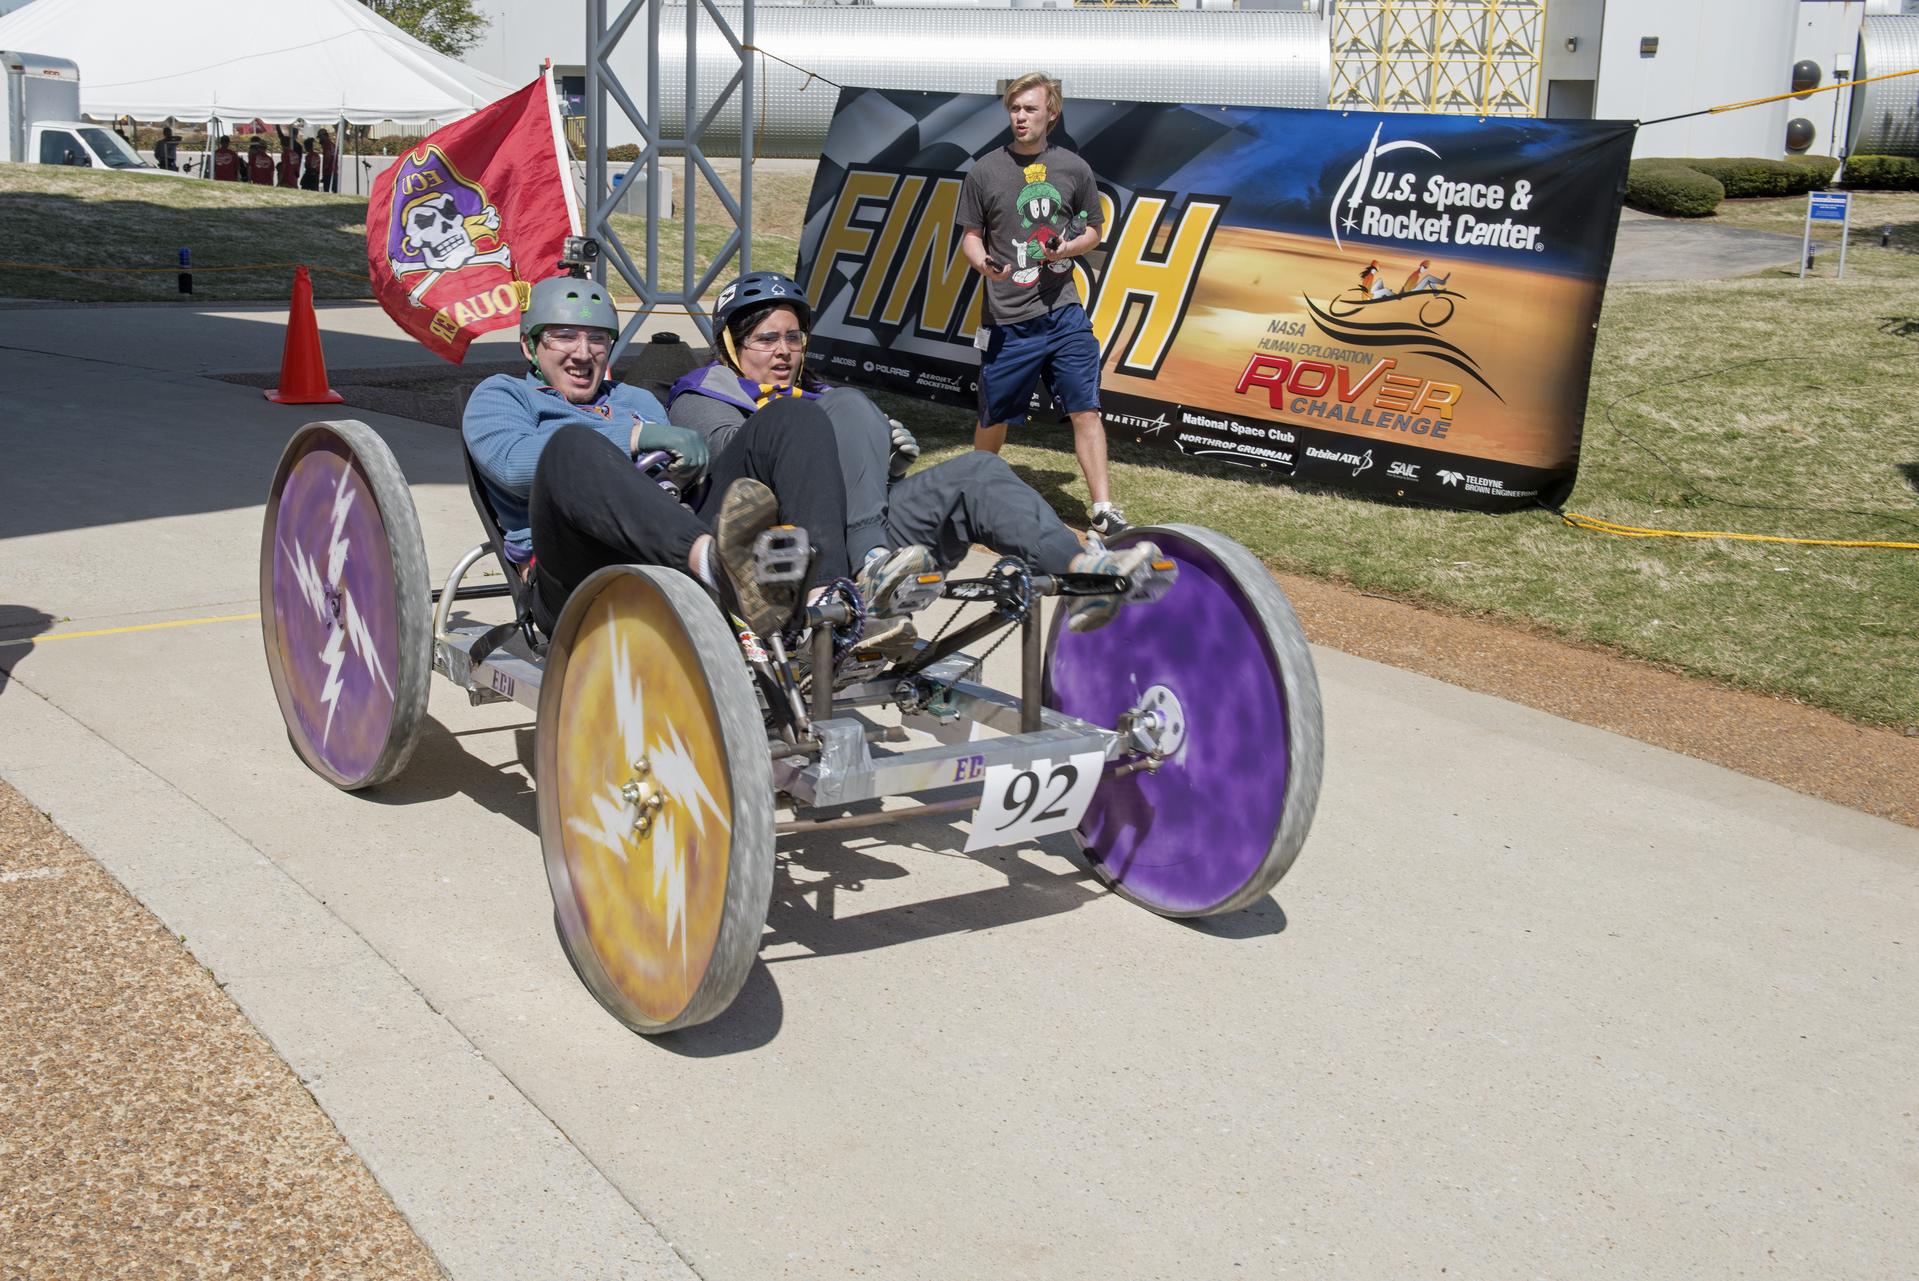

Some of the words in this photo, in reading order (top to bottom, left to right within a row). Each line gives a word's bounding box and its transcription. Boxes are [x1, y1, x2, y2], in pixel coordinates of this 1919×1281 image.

[1371, 171, 1416, 202] U.S.
[1423, 175, 1505, 211] Space
[1510, 179, 1533, 211] &
[1361, 205, 1451, 243] Rocket
[806, 169, 1222, 372] FINH
[1267, 320, 1307, 338] NASA
[1257, 337, 1299, 355] HUMAN
[1299, 343, 1374, 365] EXPLORATION
[875, 363, 911, 378] POLARIS
[1235, 352, 1464, 420] ROVER
[1105, 413, 1150, 428] MARTIN
[1182, 412, 1229, 431] National
[1230, 421, 1266, 438] Space
[1268, 428, 1295, 443] Club
[1290, 397, 1452, 439] CHALLENGE
[1179, 433, 1237, 450] NORTHROP
[1237, 444, 1293, 461] GRUMMAN
[1306, 447, 1340, 461] Orbital
[1340, 453, 1362, 466] ATK
[1386, 461, 1422, 479] SAIC
[1466, 475, 1504, 489] TELEDYNE
[1465, 483, 1490, 494] BROWN
[492, 669, 515, 697] ECU
[953, 754, 985, 782] EC
[995, 764, 1078, 831] 92
